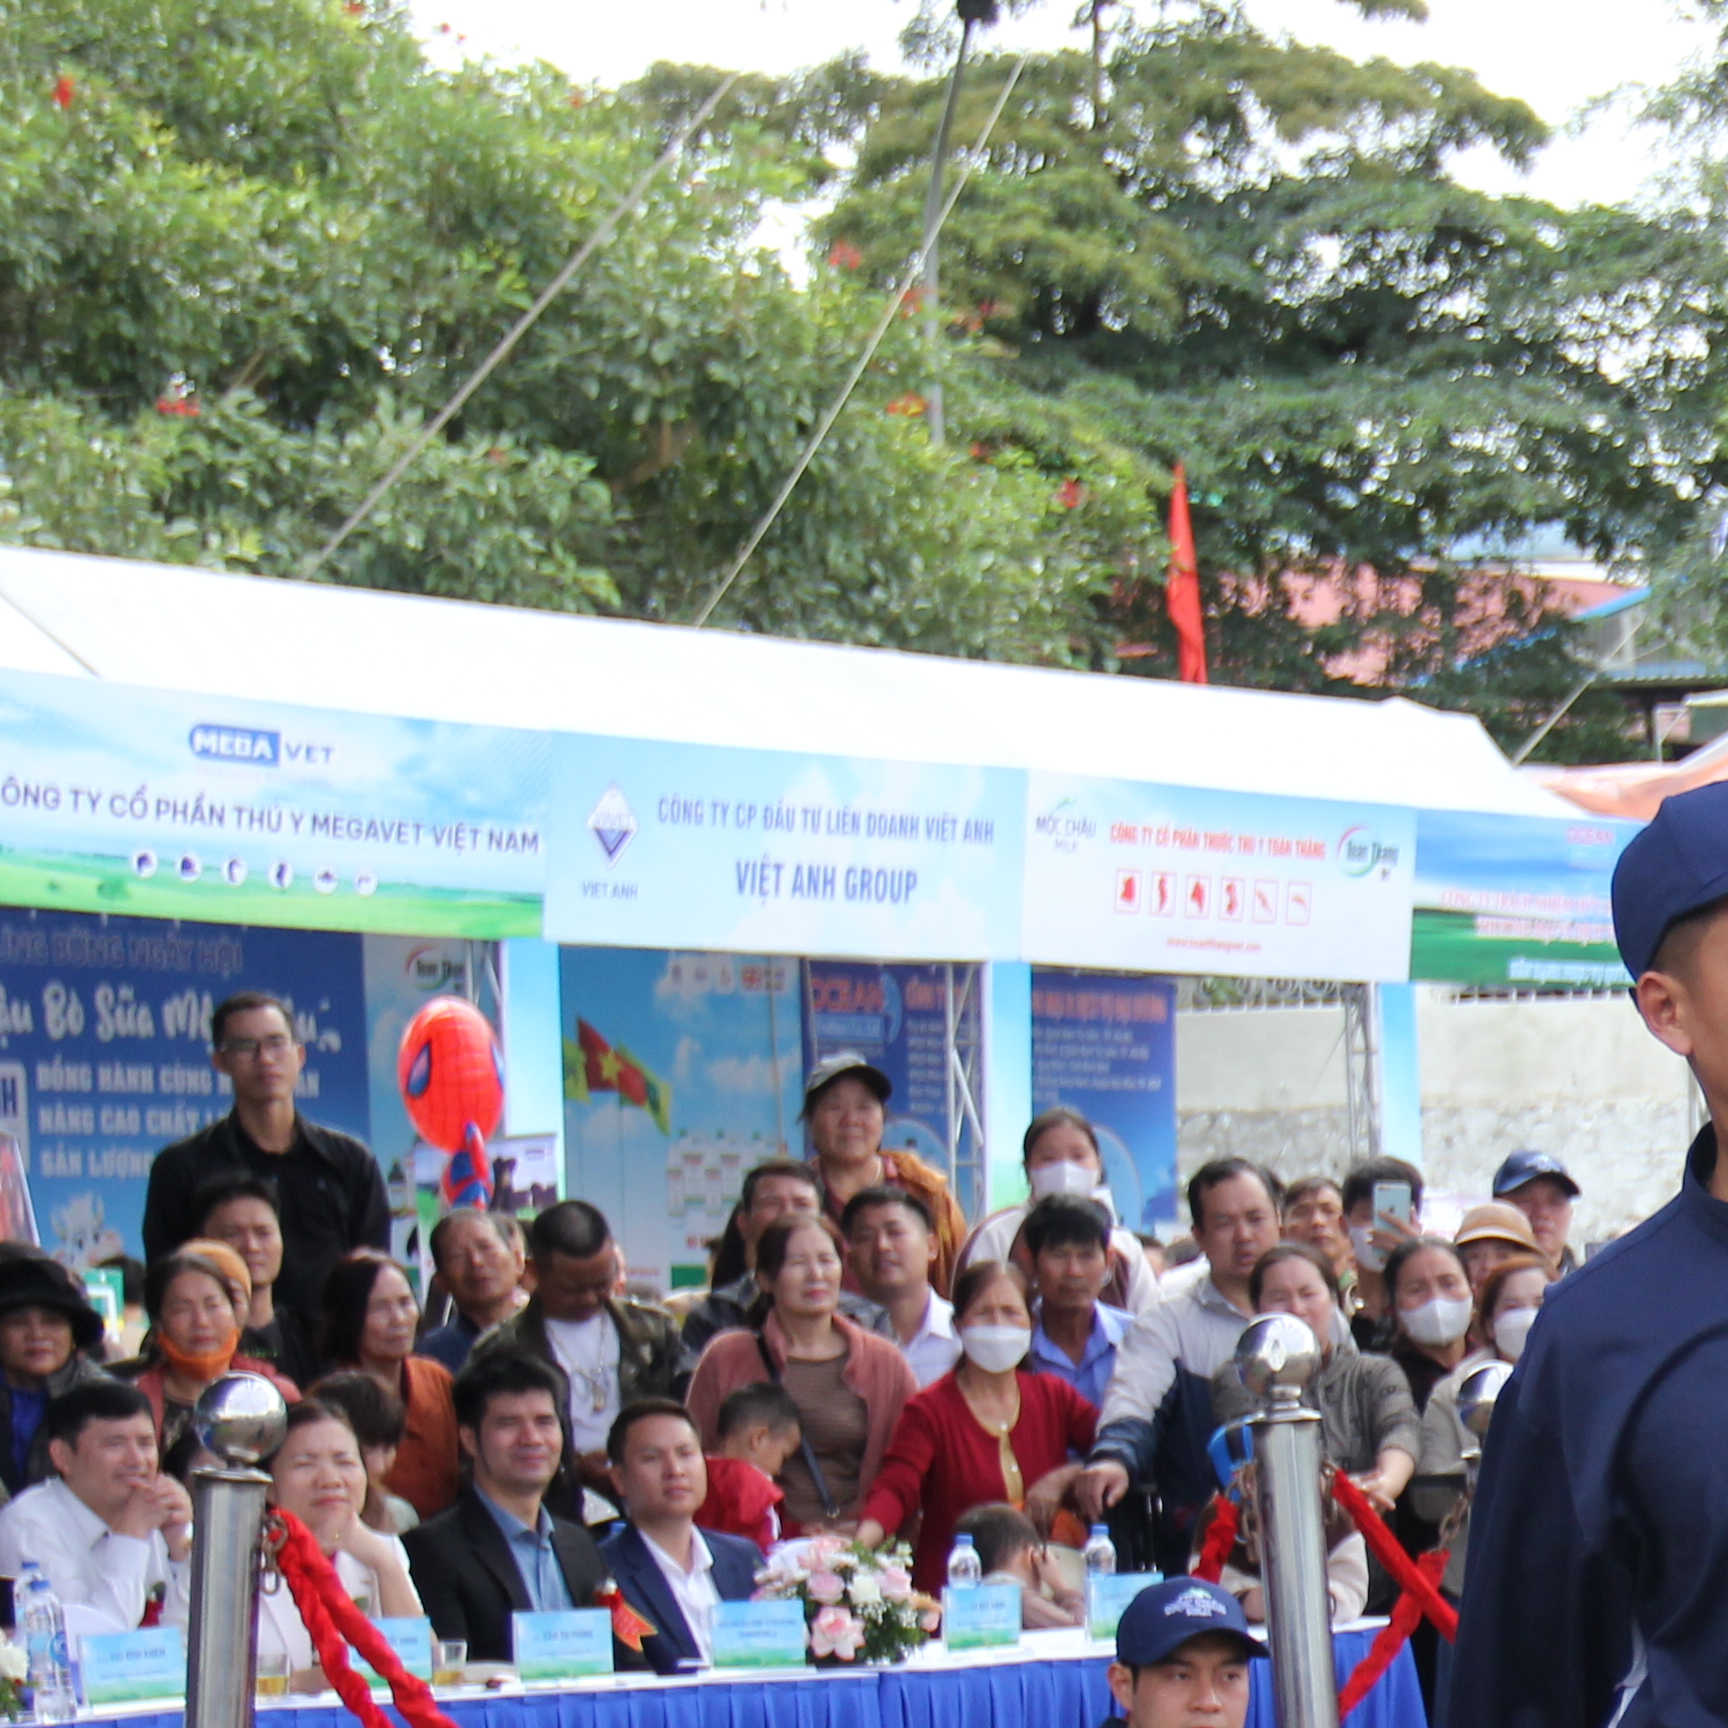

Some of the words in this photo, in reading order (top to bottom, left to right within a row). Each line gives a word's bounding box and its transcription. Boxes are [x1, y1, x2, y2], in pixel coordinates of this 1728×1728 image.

[285, 743, 335, 763] VET
[0, 774, 62, 811] ÔNG
[70, 788, 102, 813] TY
[234, 803, 283, 832] THÚ
[291, 813, 304, 834] Y
[312, 814, 424, 846] MEGAVET
[433, 822, 482, 856] VIỆT
[488, 831, 539, 854] NAM
[658, 792, 704, 826] CÔNG
[711, 802, 730, 827] TY
[736, 803, 757, 829] CP
[827, 805, 861, 836] LIÊN
[867, 812, 919, 840] DOANH
[926, 812, 958, 848] VIỆT
[963, 819, 994, 844] ANH
[736, 852, 784, 906] VIỆT
[791, 863, 837, 899] ANH
[845, 865, 918, 904] GROUP
[100, 1106, 141, 1136] CAO
